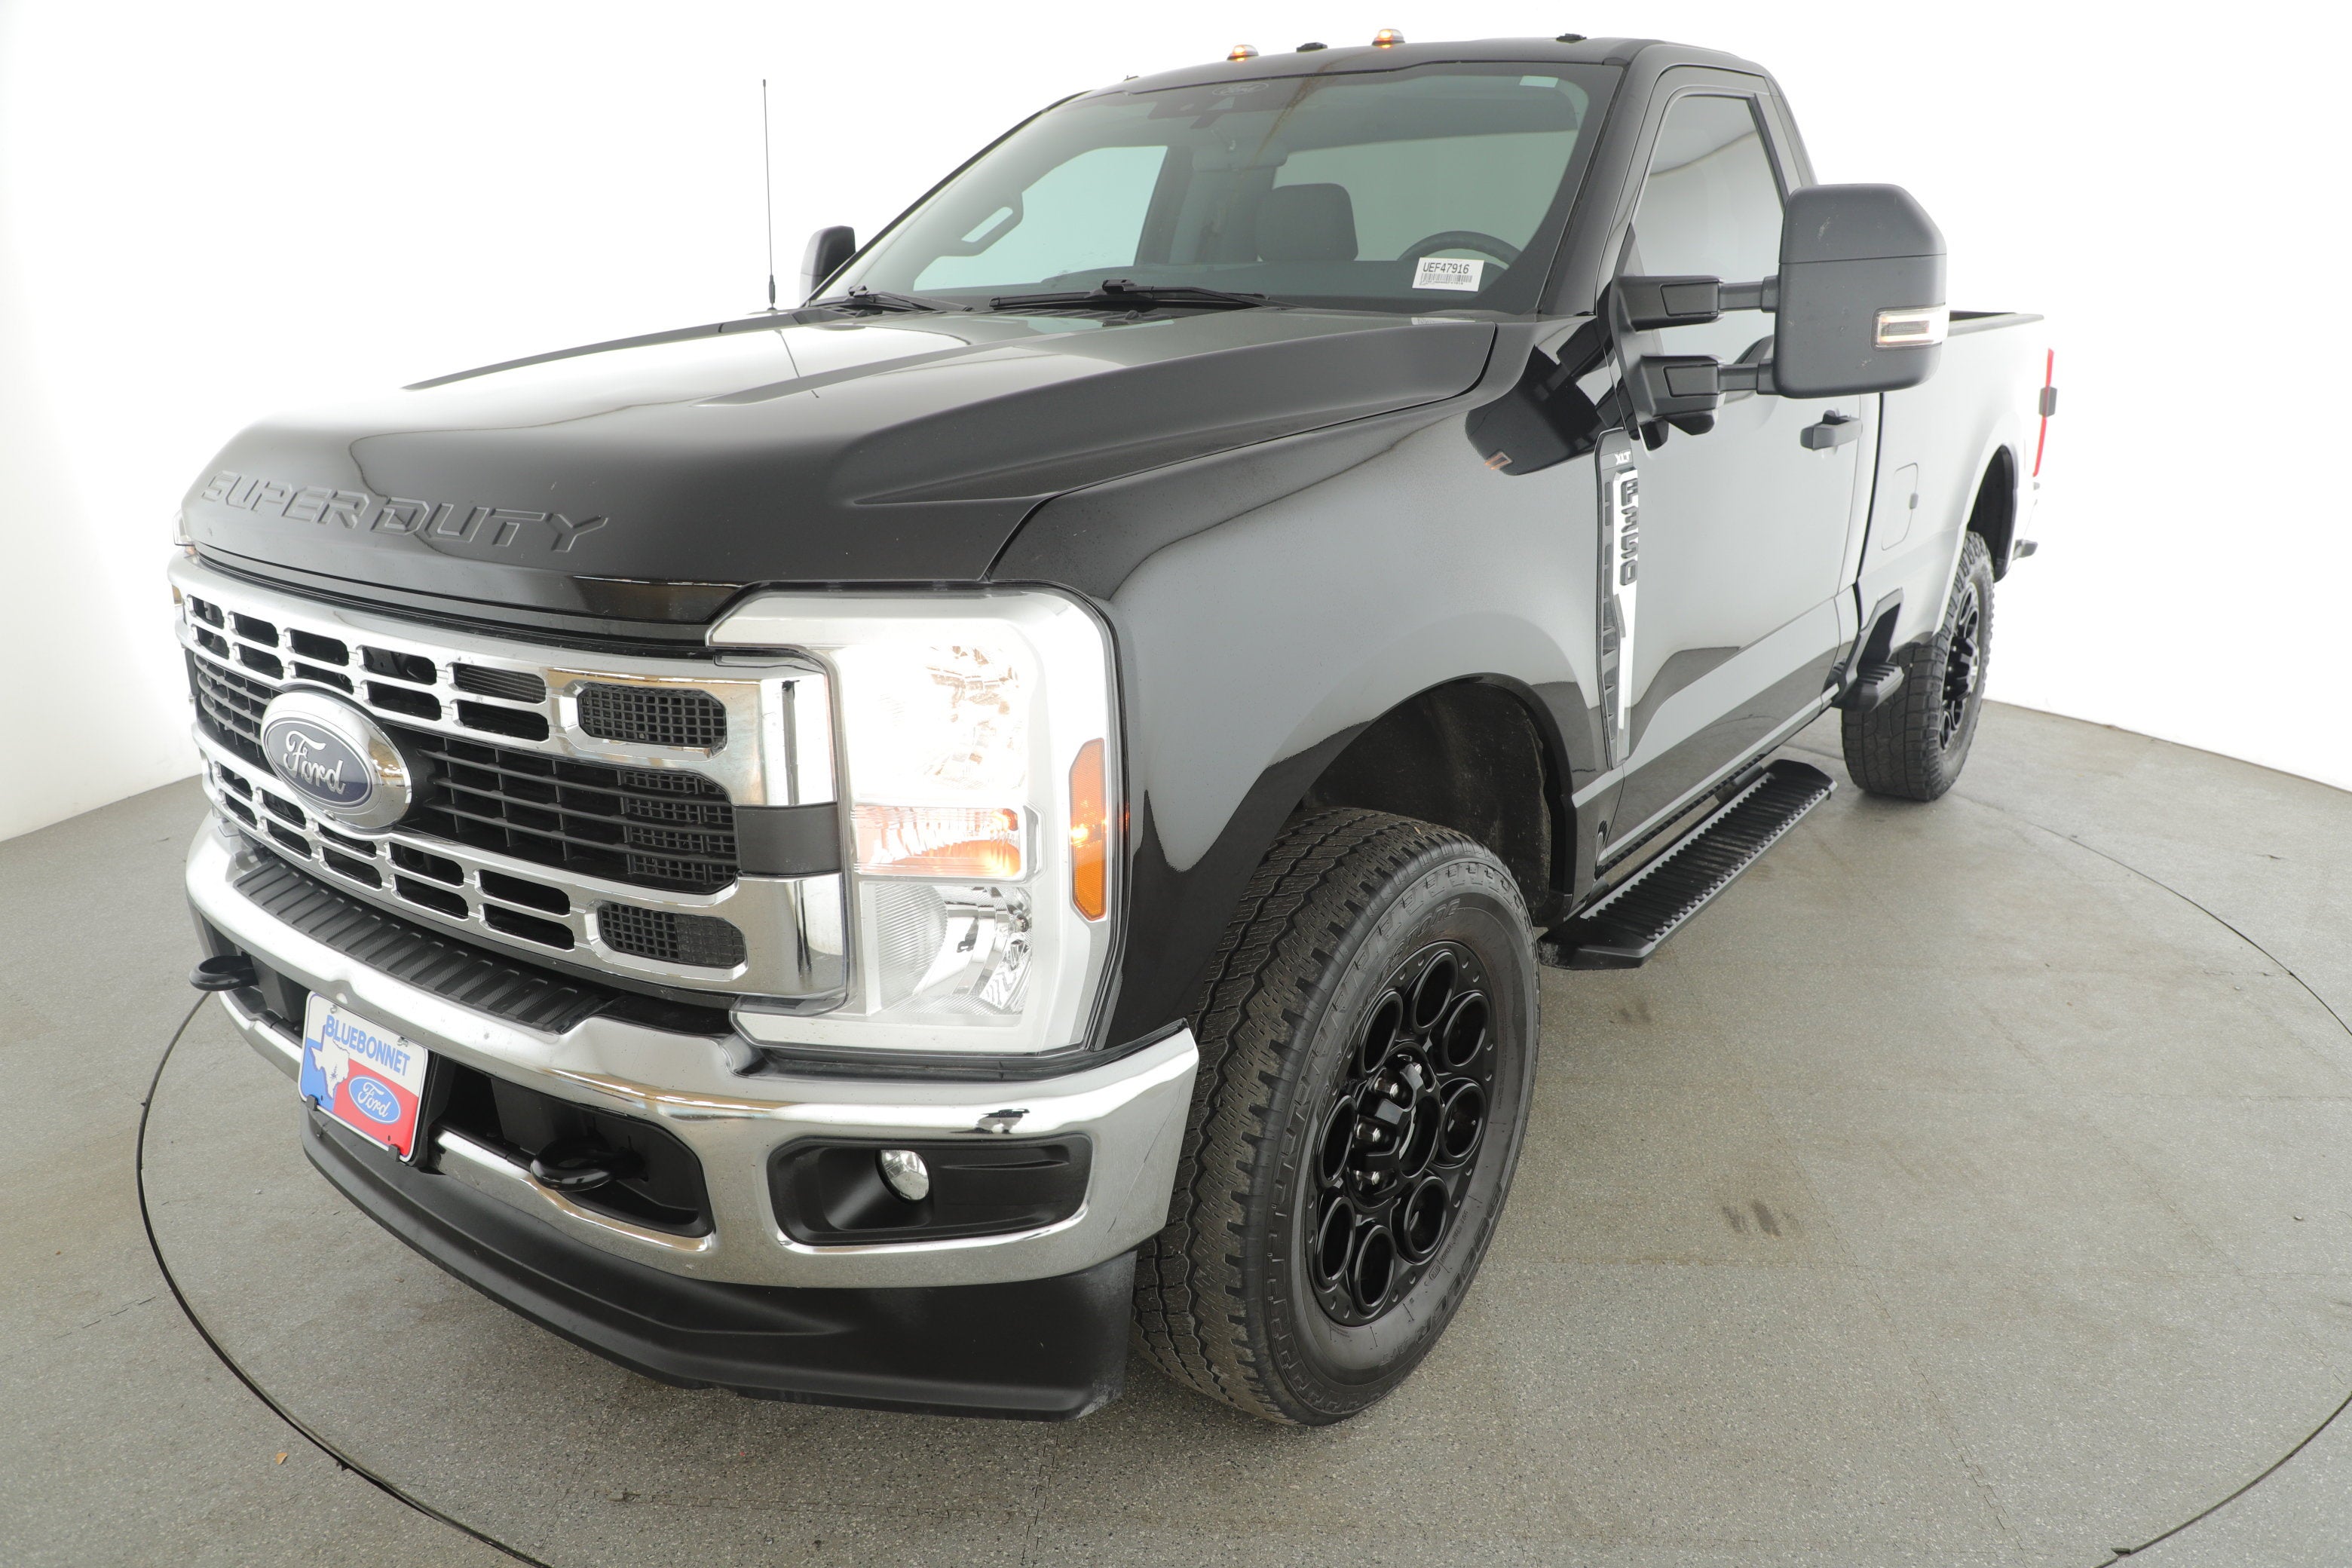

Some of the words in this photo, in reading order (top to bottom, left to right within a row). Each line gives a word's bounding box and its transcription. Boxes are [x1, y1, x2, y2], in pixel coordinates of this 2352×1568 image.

[1423, 262, 1470, 274] UEF47916
[1614, 451, 1631, 465] XLT
[200, 470, 369, 529] SUPER
[369, 495, 608, 552] DUTY
[1619, 477, 1639, 586] F350
[282, 730, 345, 796] Ford
[325, 1015, 411, 1076] BLUEBONNET
[357, 1082, 391, 1118] Ford
